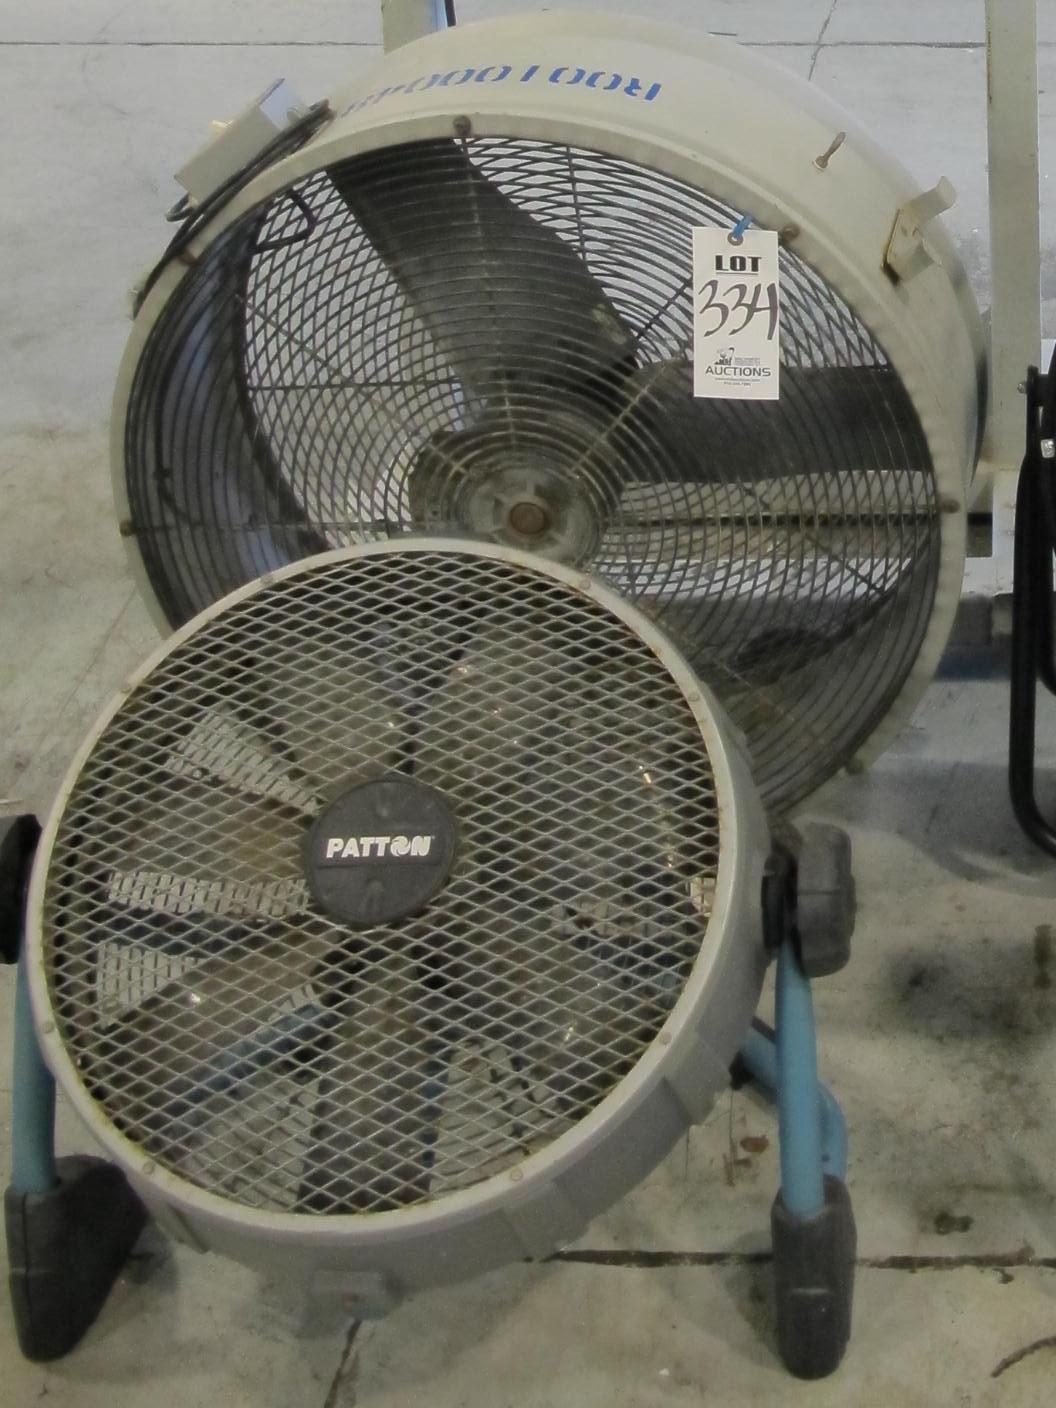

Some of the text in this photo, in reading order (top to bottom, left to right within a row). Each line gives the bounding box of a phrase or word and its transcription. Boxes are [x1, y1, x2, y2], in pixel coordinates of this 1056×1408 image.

[714, 255, 762, 272] LOT
[698, 279, 779, 340] 334
[705, 366, 771, 377] AUCTIONS
[326, 835, 432, 858] PATTON
